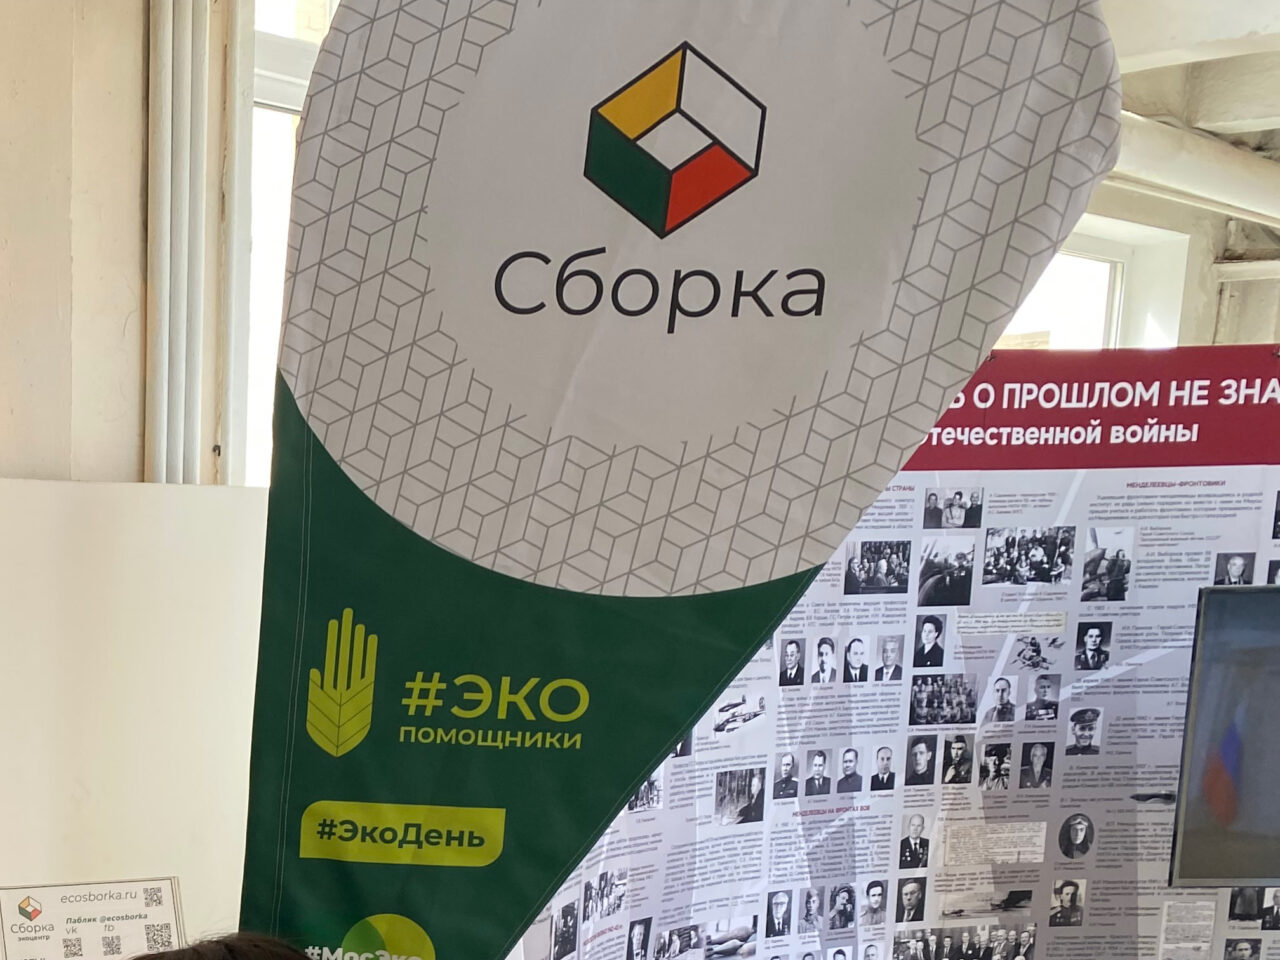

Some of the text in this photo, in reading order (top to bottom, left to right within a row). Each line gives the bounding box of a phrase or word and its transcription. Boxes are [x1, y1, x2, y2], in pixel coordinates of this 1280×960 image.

[494, 247, 826, 333] Сборка
[973, 382, 995, 409] О
[1002, 380, 1161, 409] ПРОШЛОМ
[1169, 379, 1211, 406] НЕ
[1219, 377, 1280, 405] ЗНА
[921, 418, 1199, 446] течественной войны
[401, 671, 590, 722] #ЭКО
[316, 818, 485, 849] #ЭкоДень
[60, 890, 137, 903] ecosborka.ru
[10, 923, 55, 934] Сборка
[65, 913, 148, 925] Паблик @ecosborka
[65, 926, 78, 934] vk
